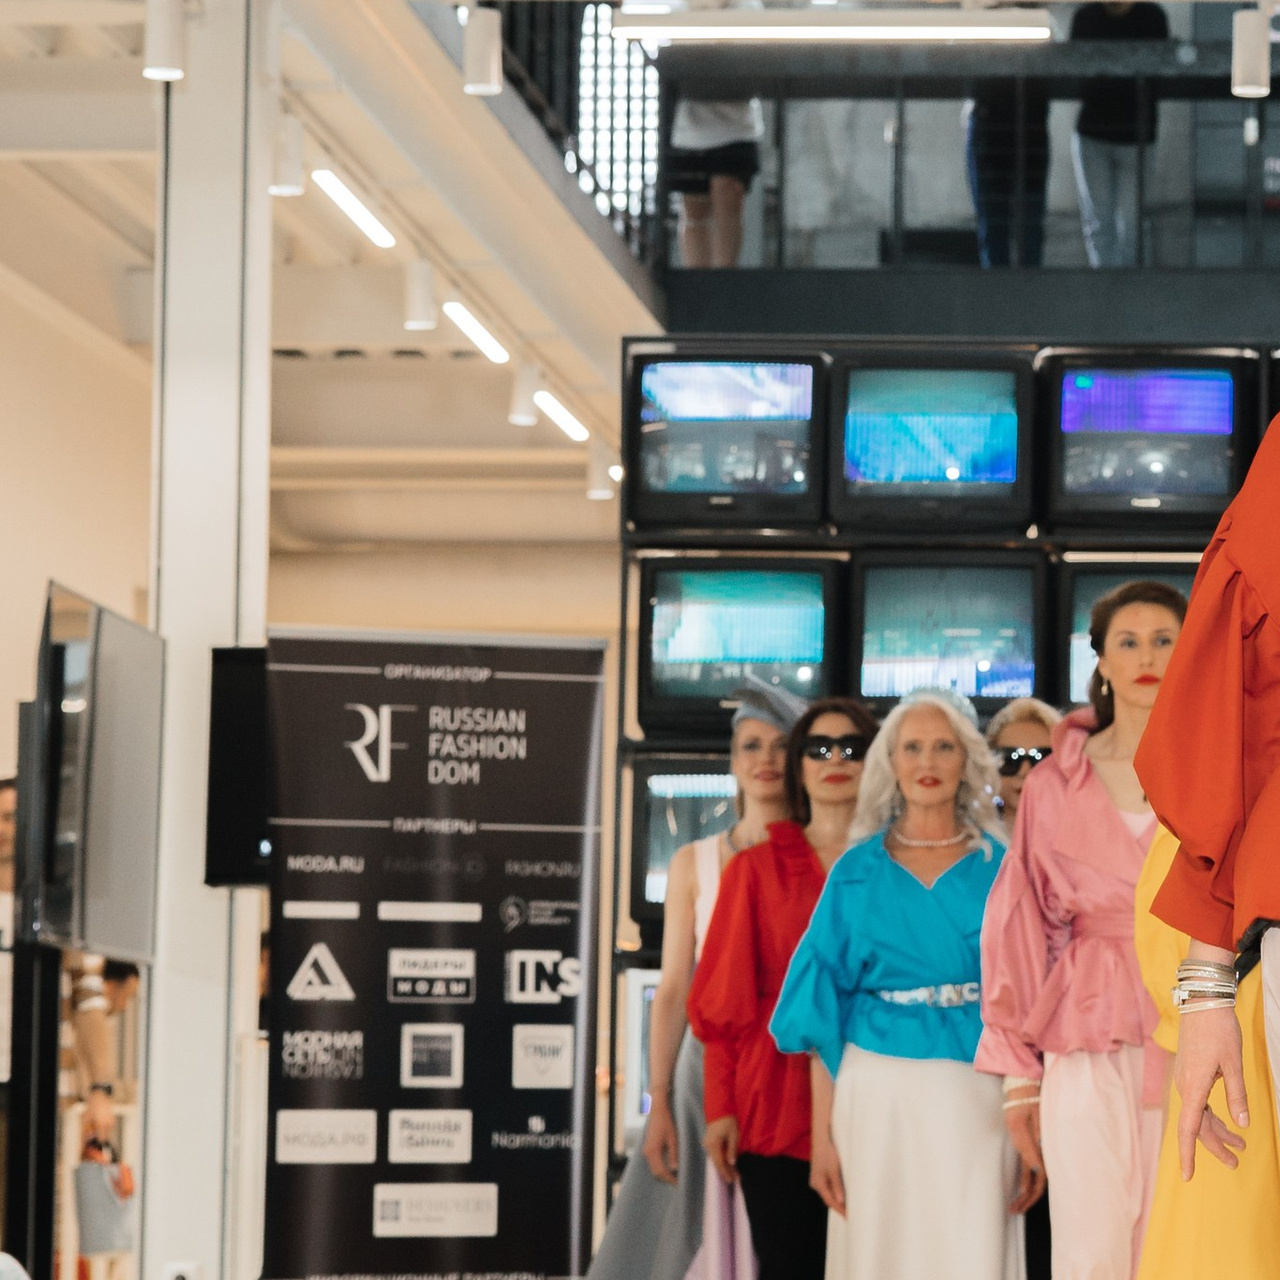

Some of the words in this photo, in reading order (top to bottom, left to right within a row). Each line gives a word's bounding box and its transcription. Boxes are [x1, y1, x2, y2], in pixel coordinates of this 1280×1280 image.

[384, 663, 493, 683] ОРГАНИЗАТОР
[428, 705, 526, 733] RUSSIAN
[428, 734, 527, 760] FASHION
[427, 761, 480, 785] DOM
[393, 817, 477, 835] ПАРТНЕРЫ
[287, 855, 365, 874] MODA.RU
